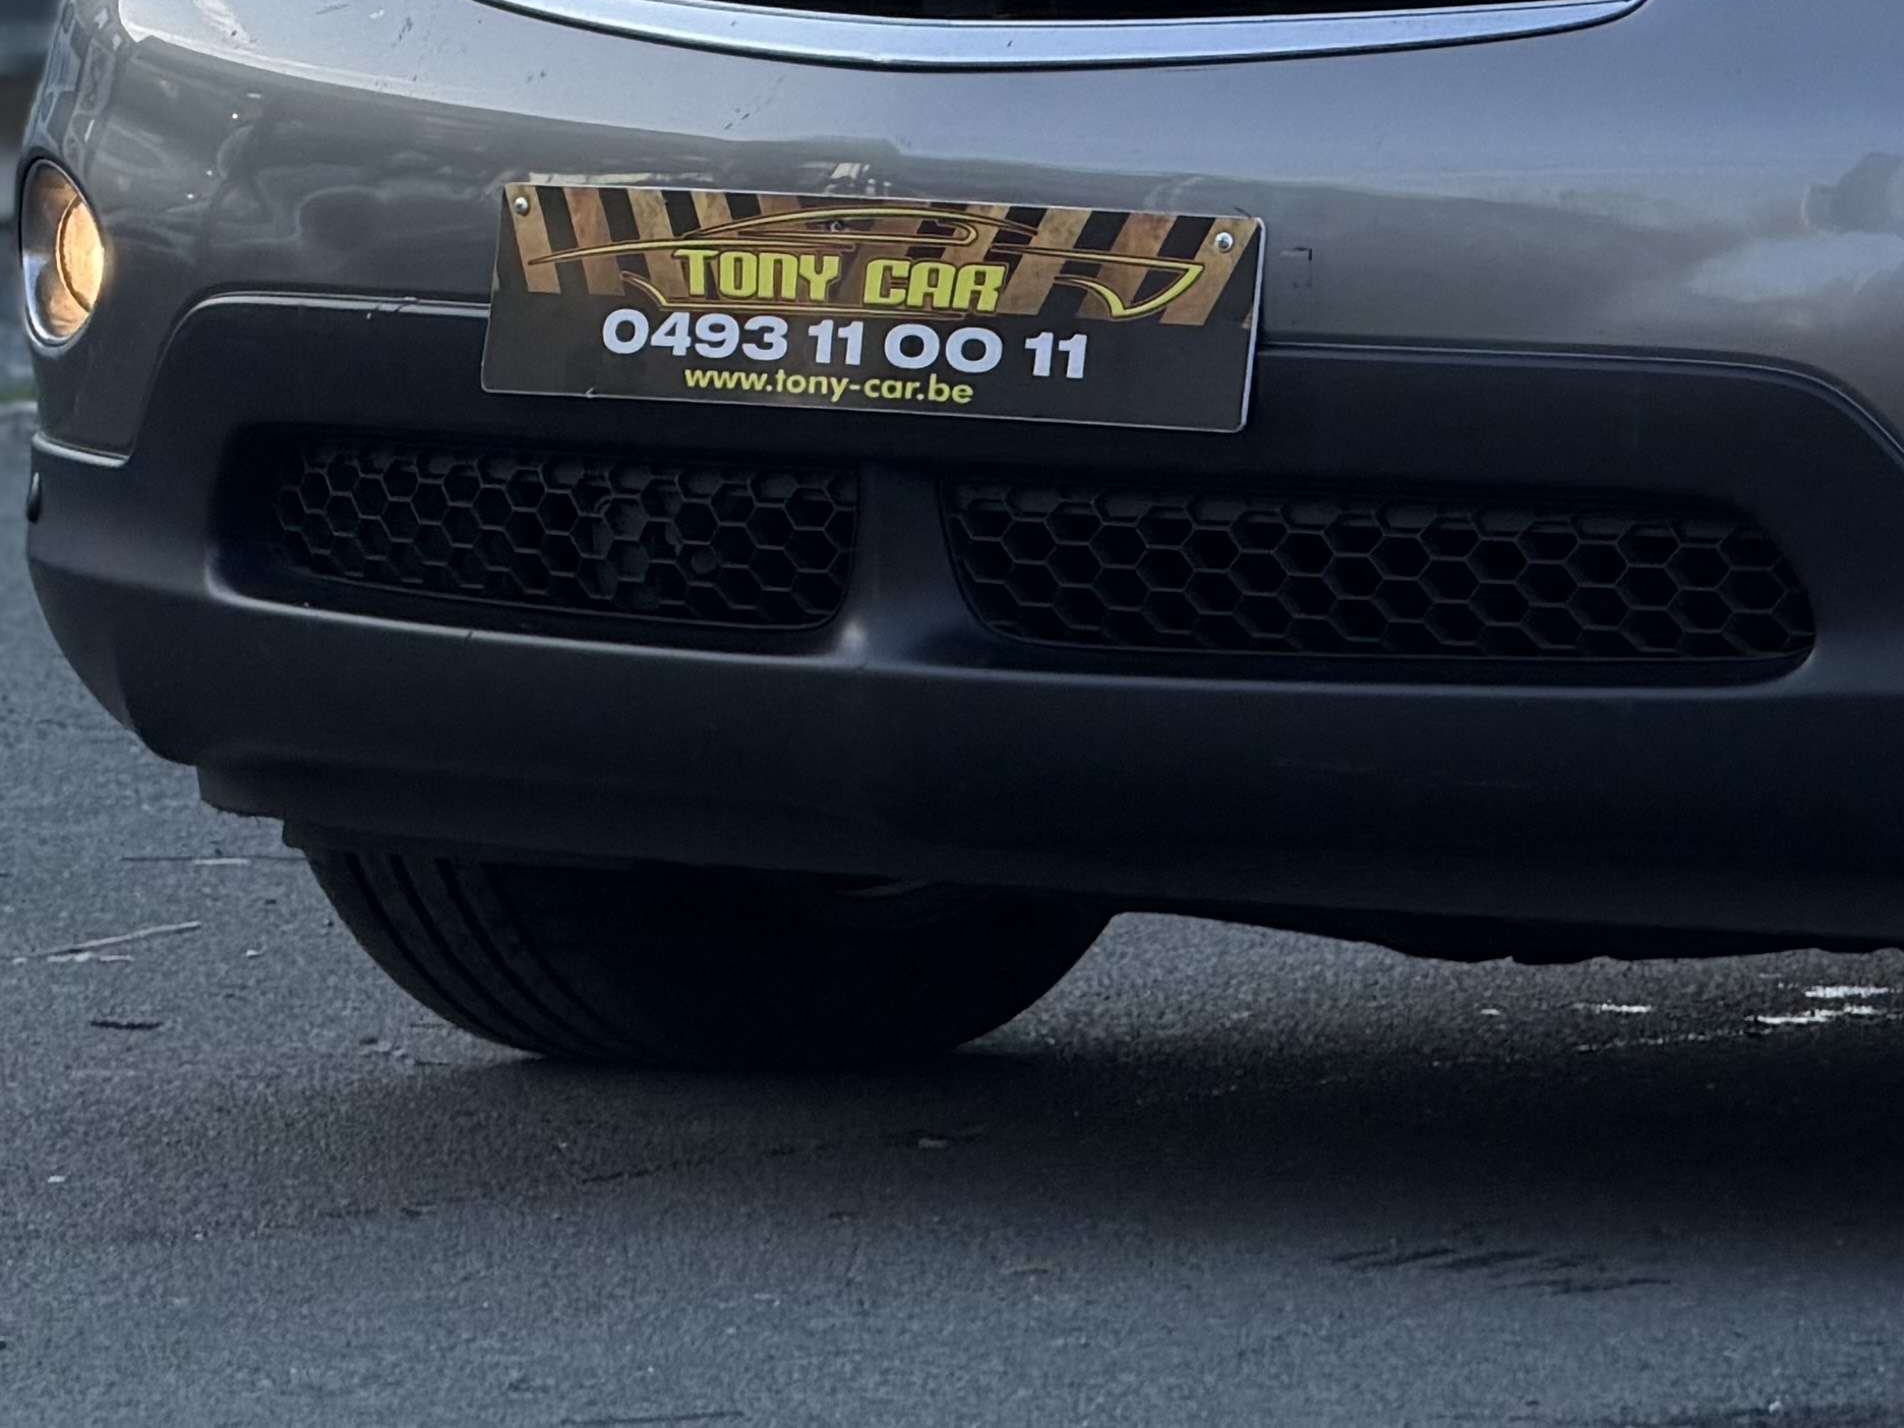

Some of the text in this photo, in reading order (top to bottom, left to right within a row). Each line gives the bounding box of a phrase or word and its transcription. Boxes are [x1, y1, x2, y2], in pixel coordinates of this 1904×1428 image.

[673, 249, 1006, 312] TONY CAR
[602, 308, 1088, 379] 0493 11 00 11
[685, 368, 974, 404] www.tony-car.be
